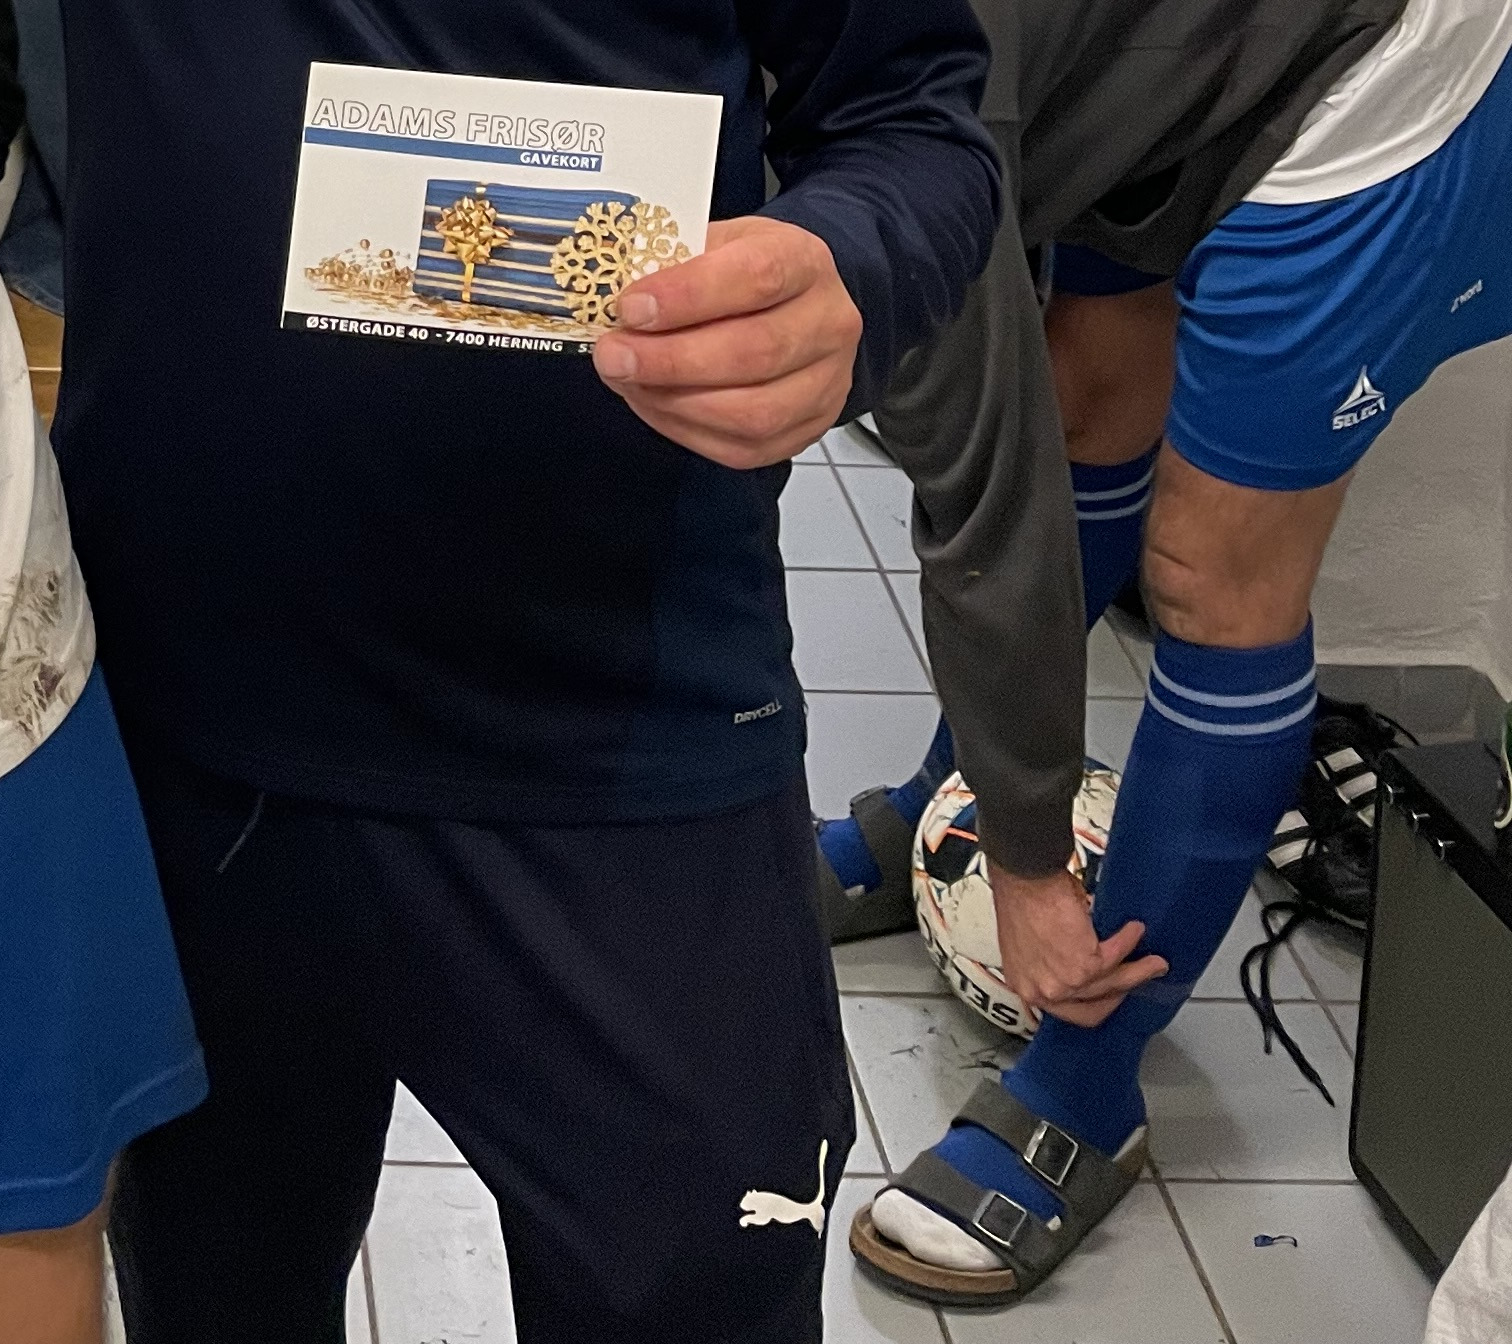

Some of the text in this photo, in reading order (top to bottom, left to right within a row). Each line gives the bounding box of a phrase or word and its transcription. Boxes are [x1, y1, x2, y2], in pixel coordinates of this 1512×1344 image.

[311, 97, 606, 154] ADAMS FRISØR
[519, 151, 600, 170] GAVEKORT
[306, 315, 406, 338] ØSTERGADE
[408, 326, 429, 341] 40
[446, 330, 485, 347] 7400
[488, 334, 564, 352] HERNING
[1332, 396, 1386, 430] SELECT
